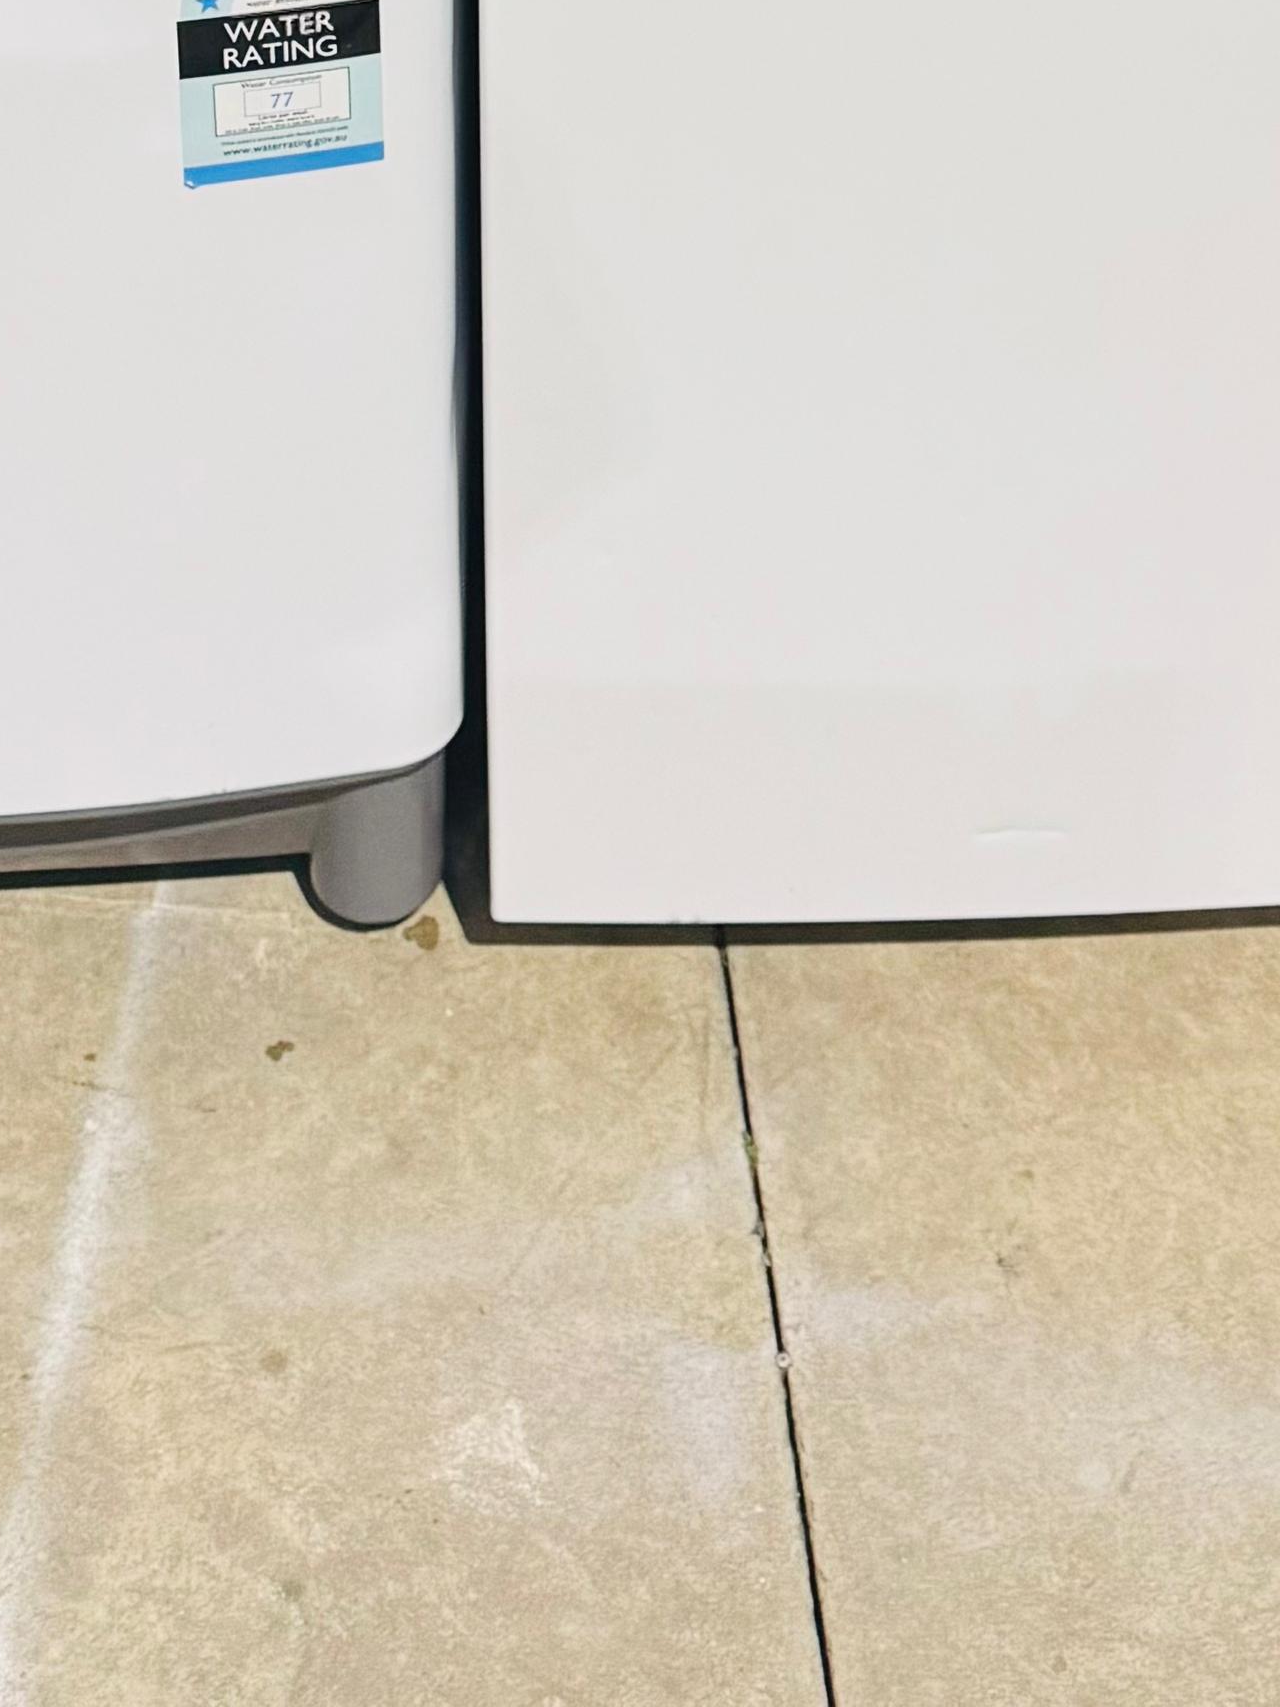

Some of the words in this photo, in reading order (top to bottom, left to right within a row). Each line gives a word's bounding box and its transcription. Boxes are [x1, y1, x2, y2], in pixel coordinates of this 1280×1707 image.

[223, 10, 334, 43] WATER
[222, 35, 338, 70] RATING
[270, 91, 295, 109] 77
